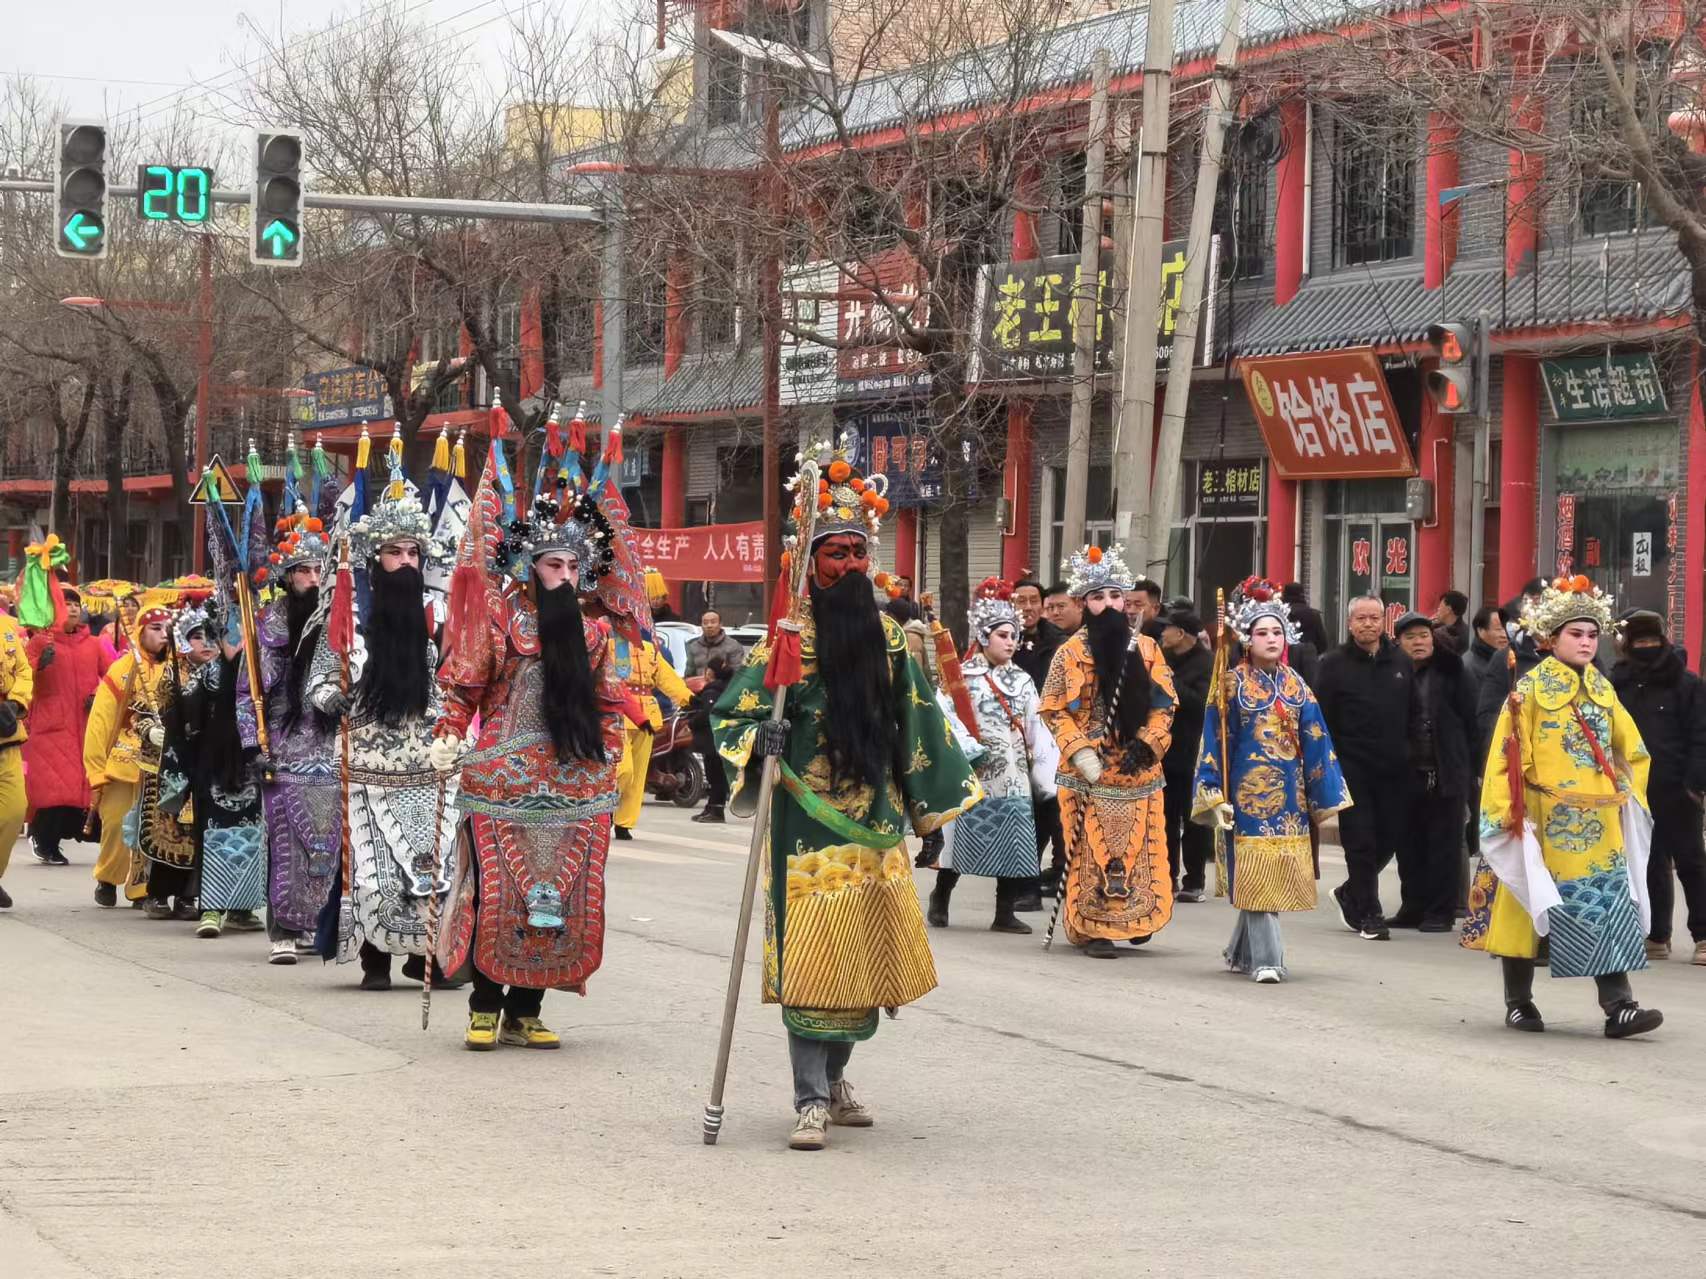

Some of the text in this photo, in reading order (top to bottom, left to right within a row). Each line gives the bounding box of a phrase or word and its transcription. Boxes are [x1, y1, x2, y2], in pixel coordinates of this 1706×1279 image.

[143, 166, 207, 220] 20
[1566, 363, 1656, 410] 生活超市
[1273, 372, 1397, 458] 饸饹店
[636, 532, 765, 561] 全生产 人人有责
